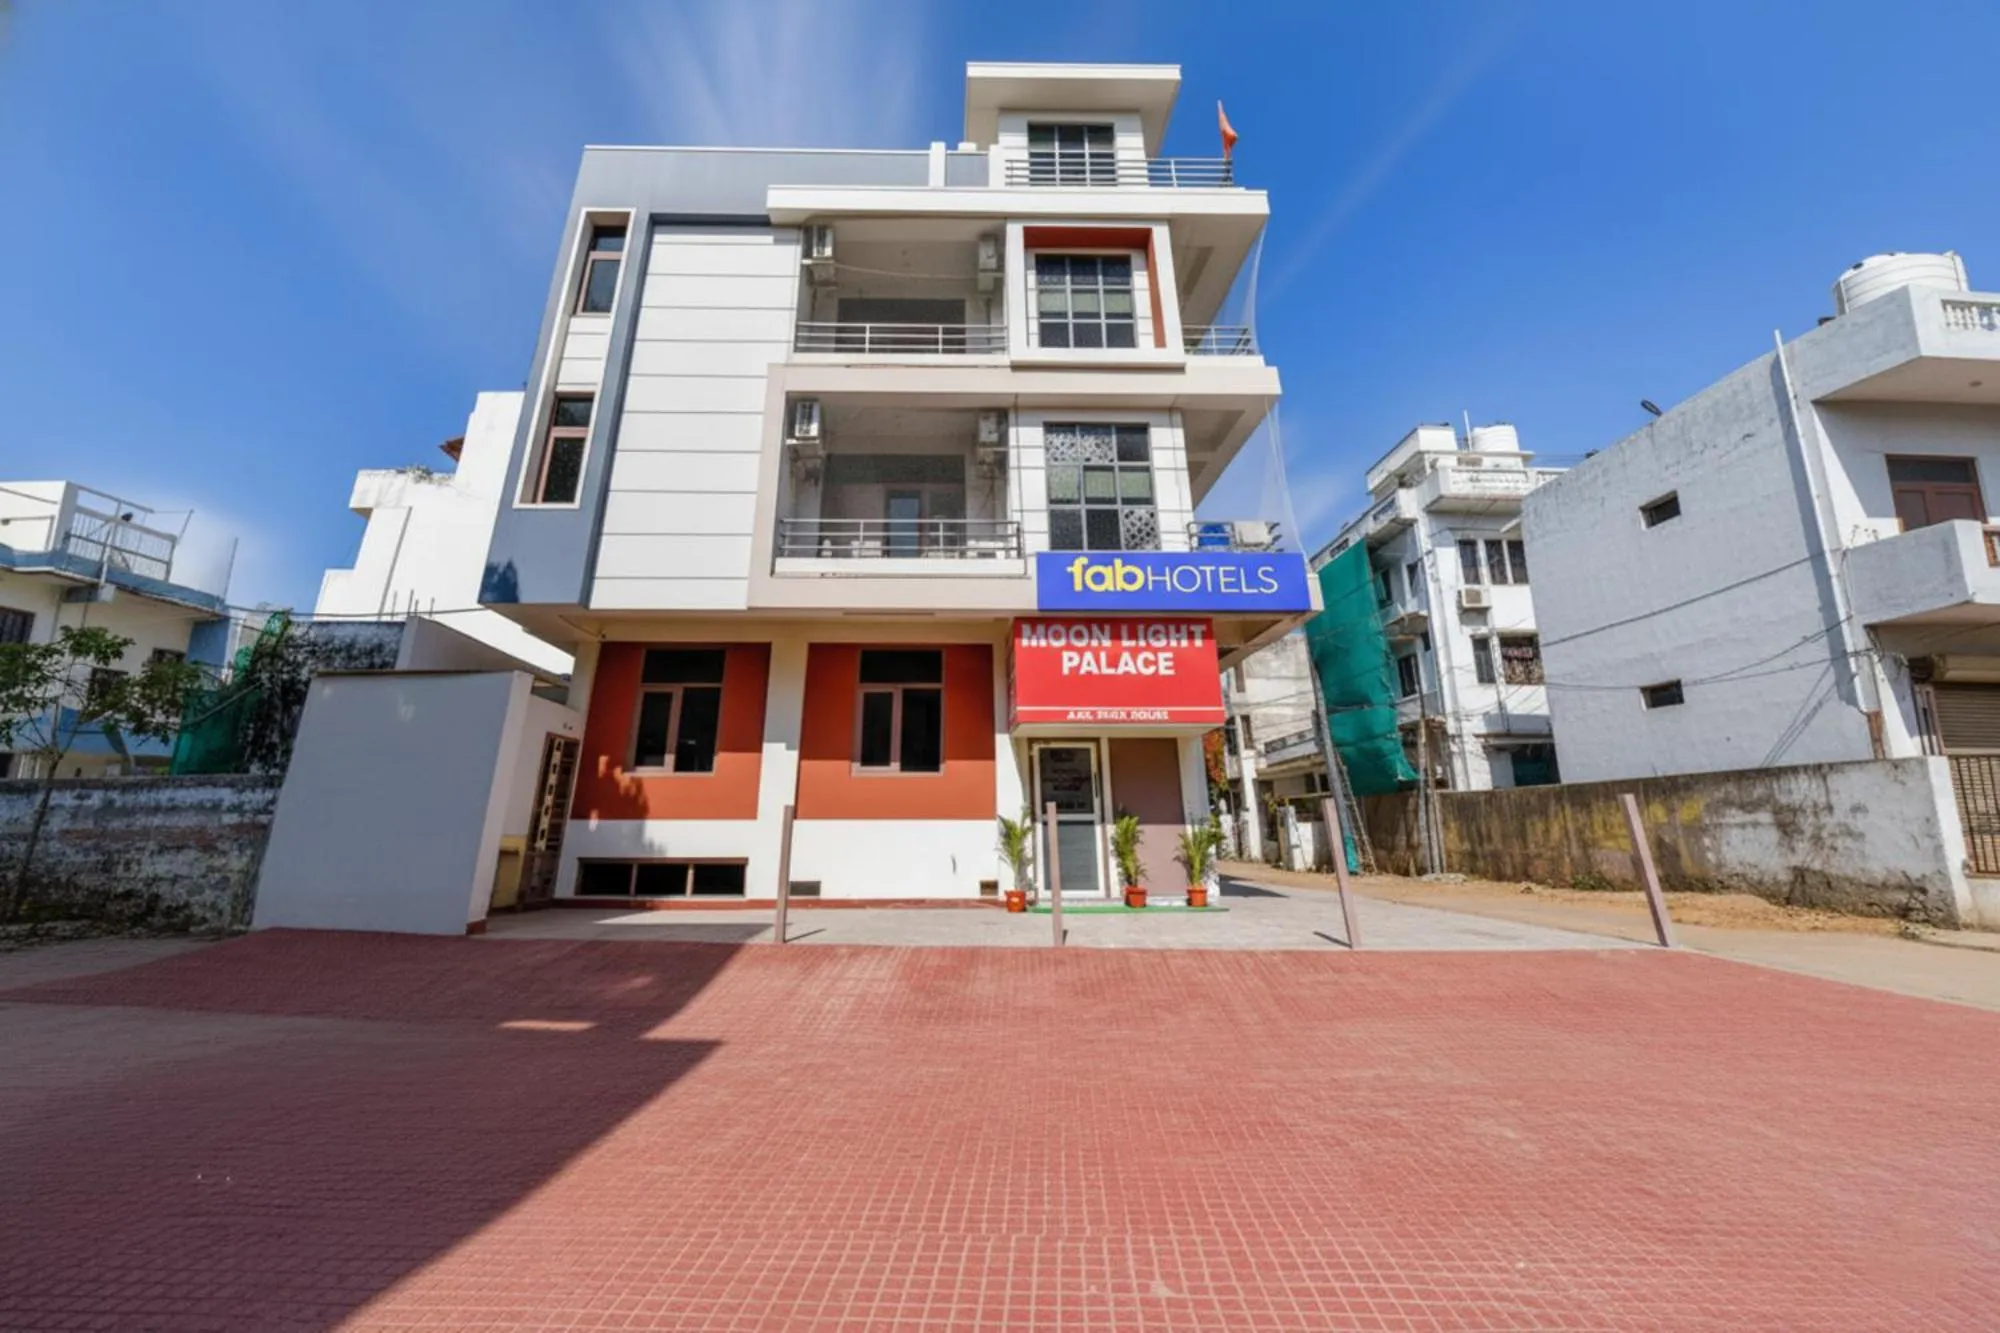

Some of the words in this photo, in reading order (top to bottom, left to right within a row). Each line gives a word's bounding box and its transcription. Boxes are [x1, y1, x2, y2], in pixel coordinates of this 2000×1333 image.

[1021, 623, 1112, 647] MOON
[1120, 624, 1206, 648] LIGHT
[1061, 651, 1175, 676] PALACE
